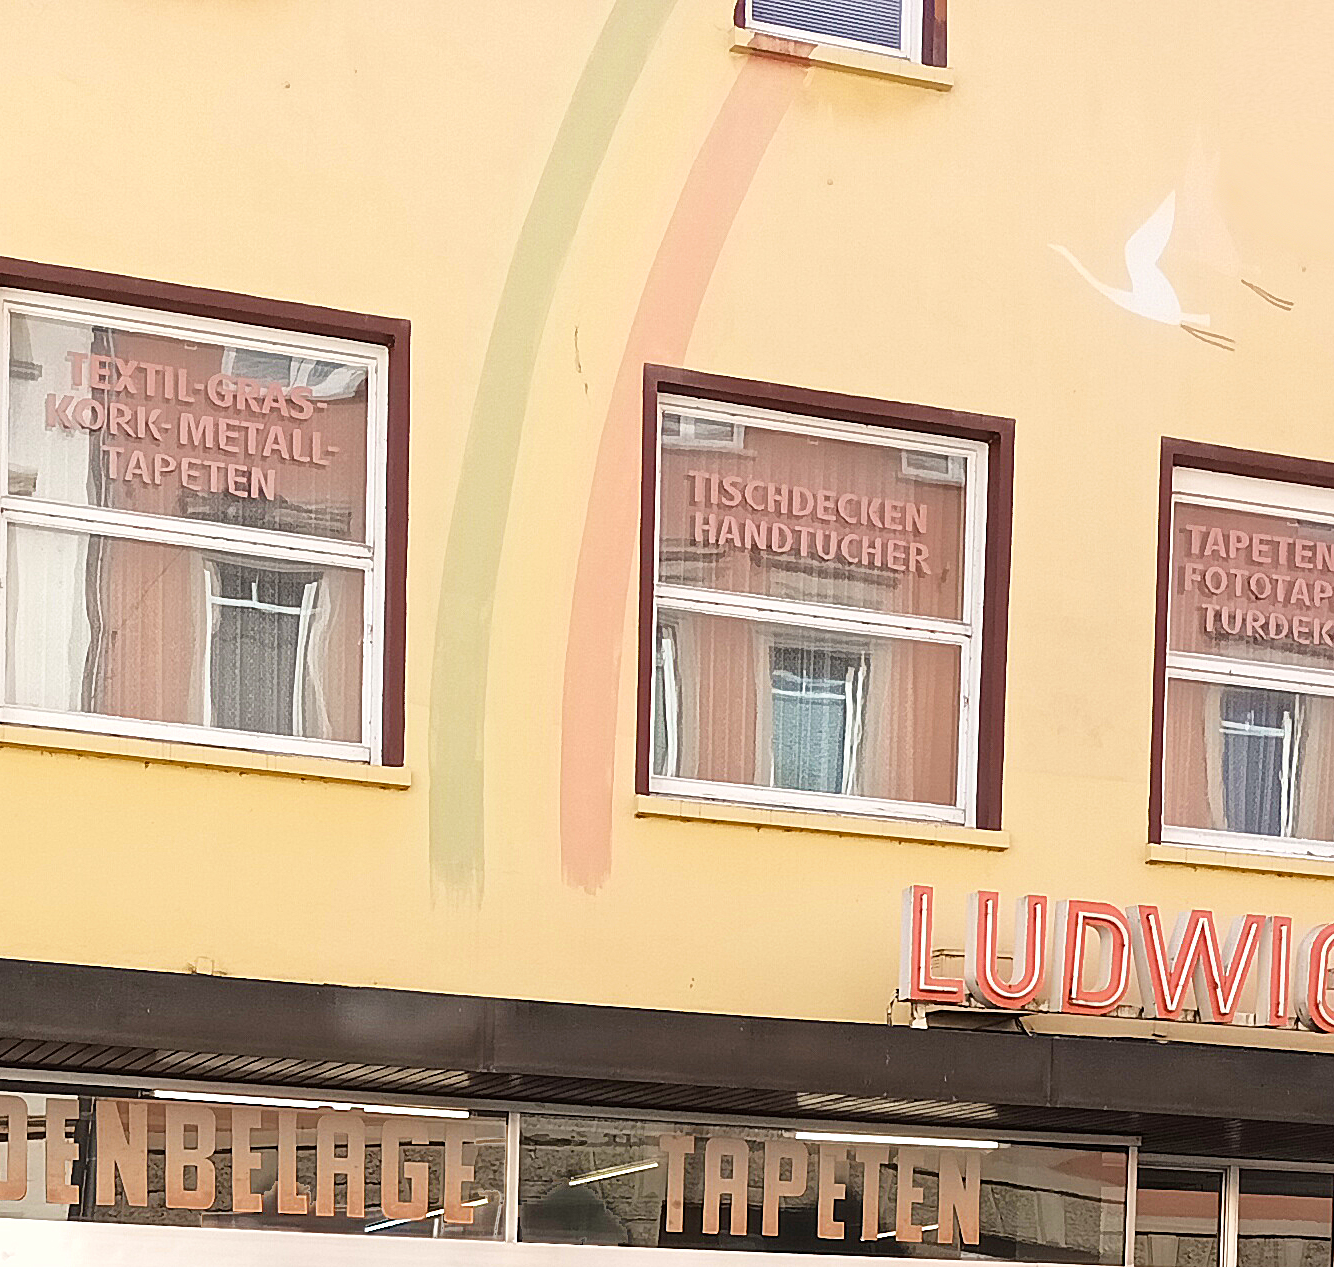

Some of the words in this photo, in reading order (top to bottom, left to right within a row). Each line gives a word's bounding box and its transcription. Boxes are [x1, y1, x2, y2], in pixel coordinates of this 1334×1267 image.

[67, 351, 328, 420] TEXTIL-GRAS-
[102, 445, 277, 501] TAPETEN
[687, 470, 928, 534] TISCHDECKEN
[659, 1133, 982, 1246] TAPETEN
